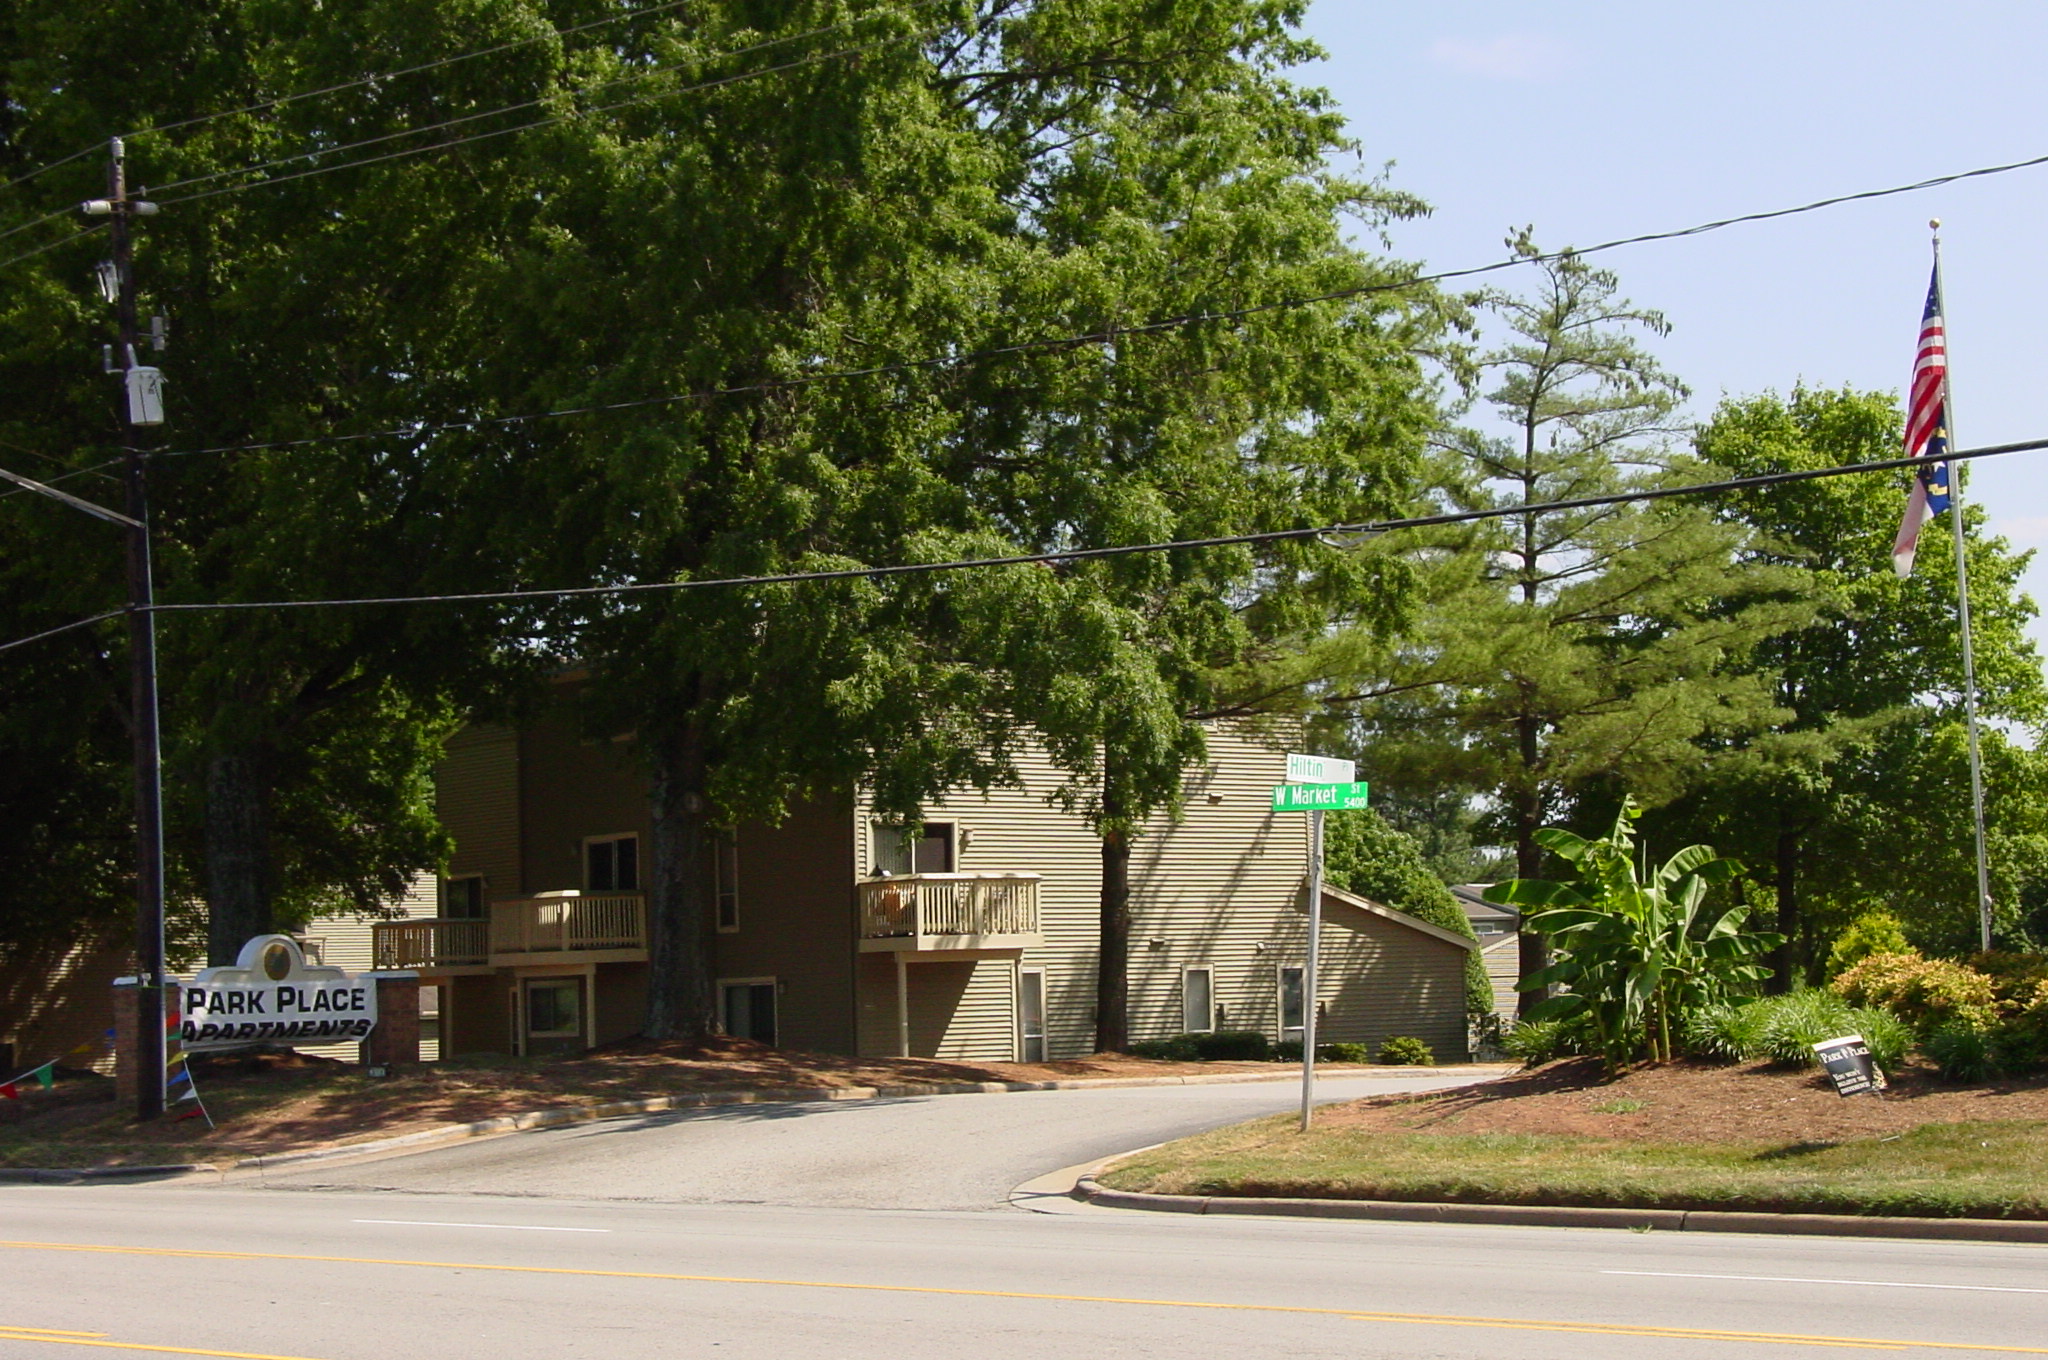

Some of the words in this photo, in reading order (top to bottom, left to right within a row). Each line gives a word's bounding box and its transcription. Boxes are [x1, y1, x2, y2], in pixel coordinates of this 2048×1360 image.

[1290, 756, 1323, 777] Hiltin
[1275, 786, 1286, 805] W
[1292, 785, 1337, 805] Market
[1351, 783, 1360, 794] St
[187, 988, 265, 1014] PARK
[277, 986, 365, 1013] PLACE
[181, 1018, 371, 1042] APARTMENTS
[1820, 1052, 1843, 1064] PARK
